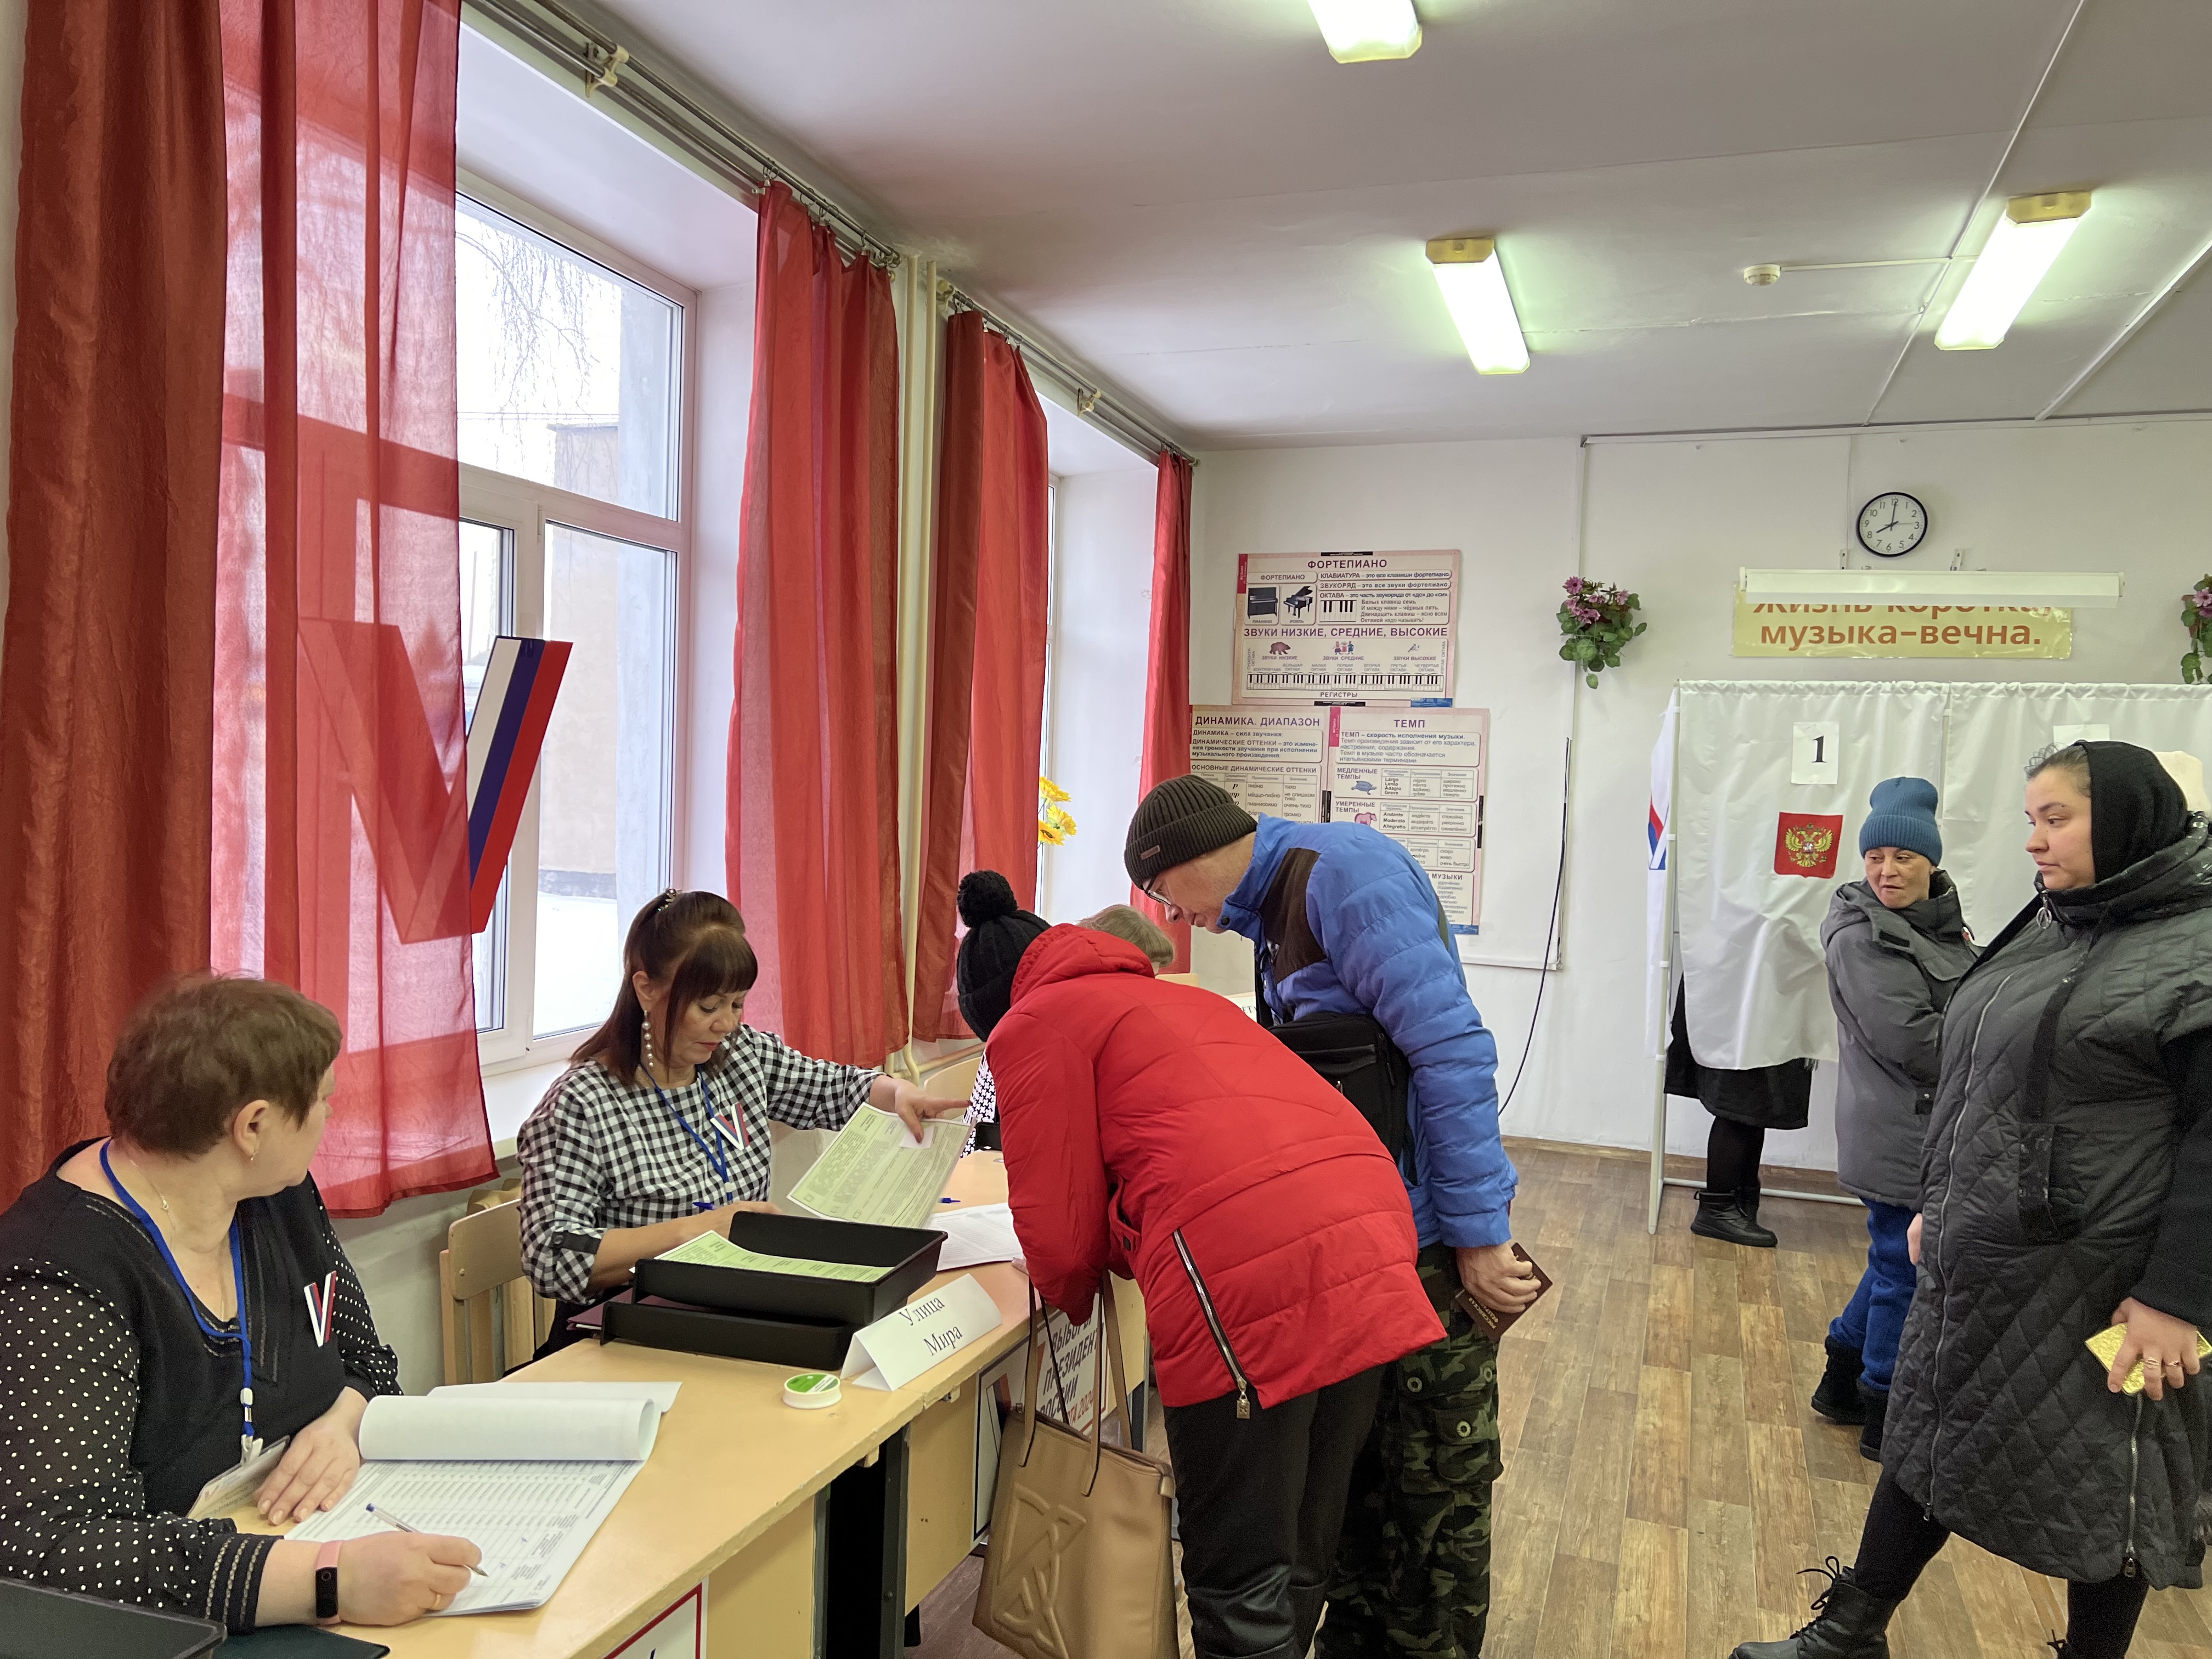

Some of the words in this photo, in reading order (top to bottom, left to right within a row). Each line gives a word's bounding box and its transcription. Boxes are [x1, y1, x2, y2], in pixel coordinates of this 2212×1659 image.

[1914, 521, 1920, 529] 3
[1307, 559, 1387, 569] ФОРТЕПИАНО
[1244, 628, 1278, 636] ЗВУКИ
[1281, 628, 1327, 637] НИЗКИЕ,
[1330, 628, 1386, 638] СРЕДНИЕ,
[1391, 628, 1447, 636] ВЫСОКИЕ
[1195, 716, 1257, 726] ДИНАМИКА.
[1260, 717, 1320, 726] ДИАПАЗОН
[1393, 719, 1425, 728] ТЕМП
[1811, 735, 1827, 763] 1
[898, 1297, 945, 1325] Улица
[923, 1326, 963, 1356] Мира
[1043, 1323, 1104, 1396] ПРЕЗИДЕН
